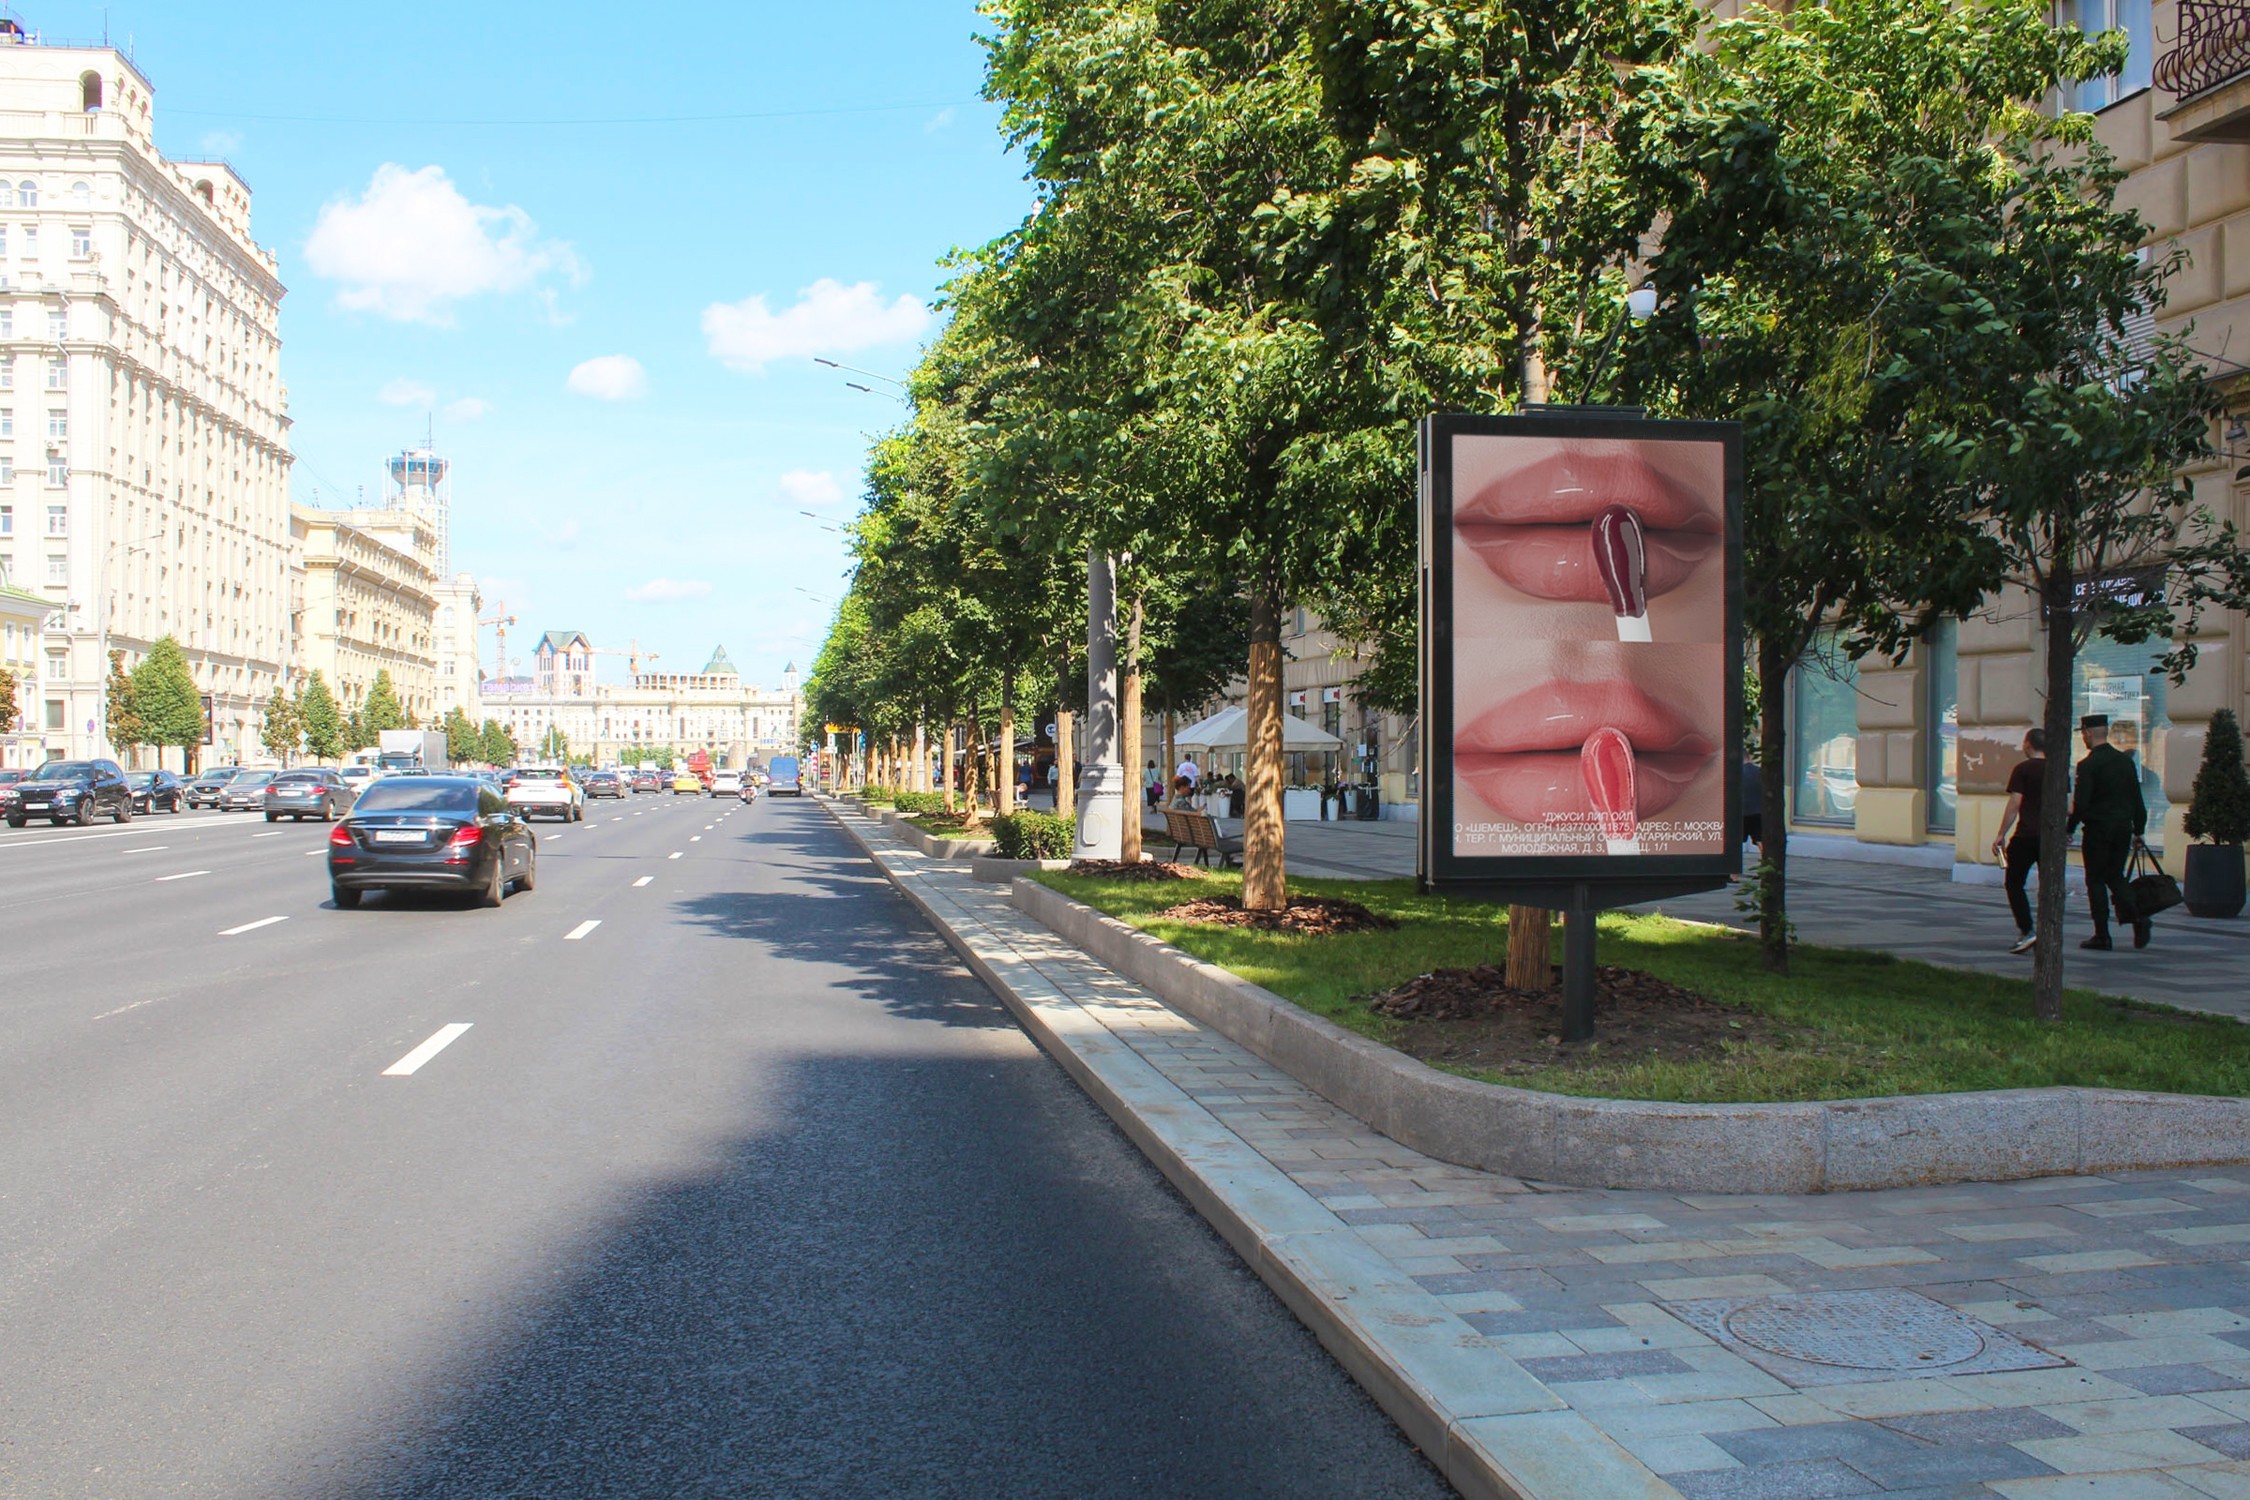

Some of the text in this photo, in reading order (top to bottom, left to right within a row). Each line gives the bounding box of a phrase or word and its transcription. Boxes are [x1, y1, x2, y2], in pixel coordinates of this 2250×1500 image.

[1587, 812, 1608, 821] ЛИП
[1610, 811, 1634, 821] ОЙЛ
[1523, 822, 1552, 832] ОГРН
[1635, 822, 1672, 832] АДРЕС:
[1674, 822, 1681, 831] Г.
[1465, 834, 1485, 843] ТЕР.
[1488, 834, 1496, 843] Г.
[1499, 832, 1595, 843] МУНИЦИПАЛЬНЫЙ
[1597, 833, 1630, 842] ОКРУГ
[1633, 831, 1706, 842] ГАГАРИНСКИЙ,
[1707, 832, 1723, 841] УЛ.
[1582, 844, 1593, 854] Д.
[1595, 844, 1605, 853] 3,
[1654, 842, 1668, 852] 1/1
